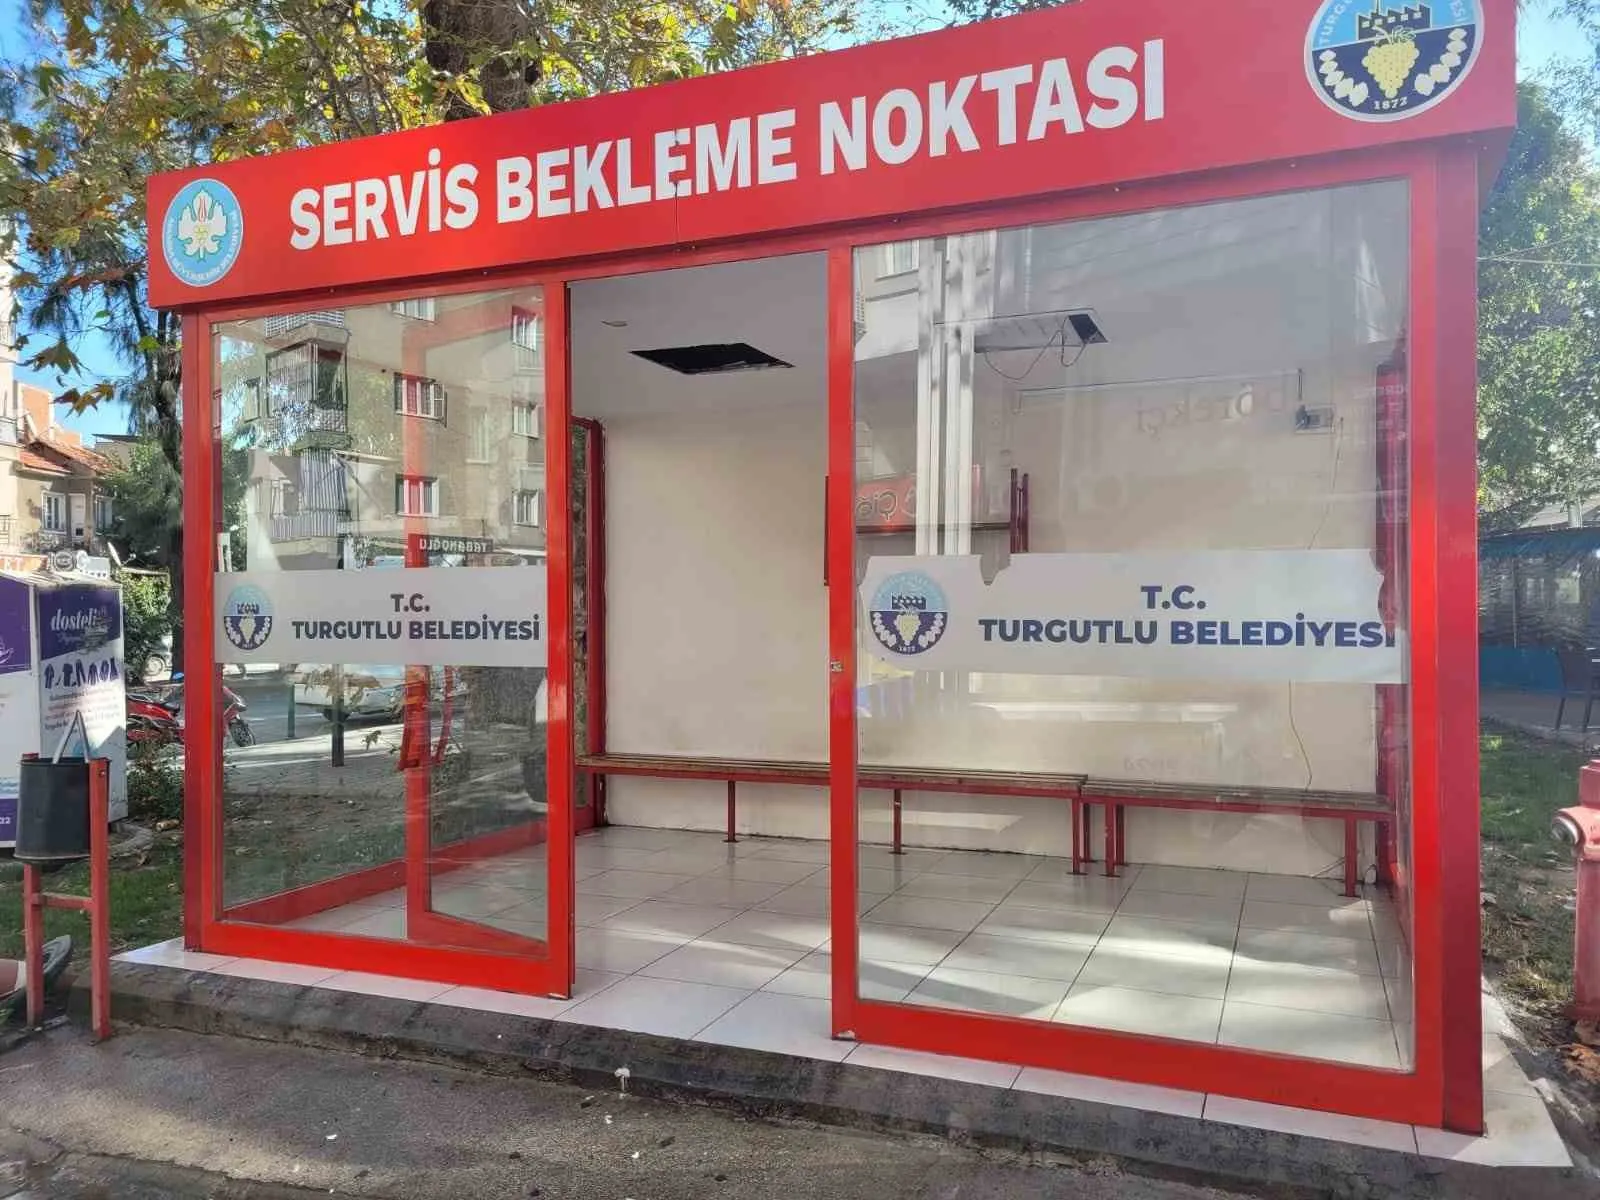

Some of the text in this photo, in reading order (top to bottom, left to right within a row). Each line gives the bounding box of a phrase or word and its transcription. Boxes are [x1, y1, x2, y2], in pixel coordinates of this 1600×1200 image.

[289, 147, 479, 250] SERVİS
[496, 109, 797, 223] BEKLEME
[819, 38, 1165, 176] NOKTASI
[390, 592, 431, 613] T.C.
[1140, 584, 1207, 610] T.C.
[291, 613, 540, 641] TURGUTLU BELEDİYESİ
[978, 618, 1158, 645] TURGUTLU
